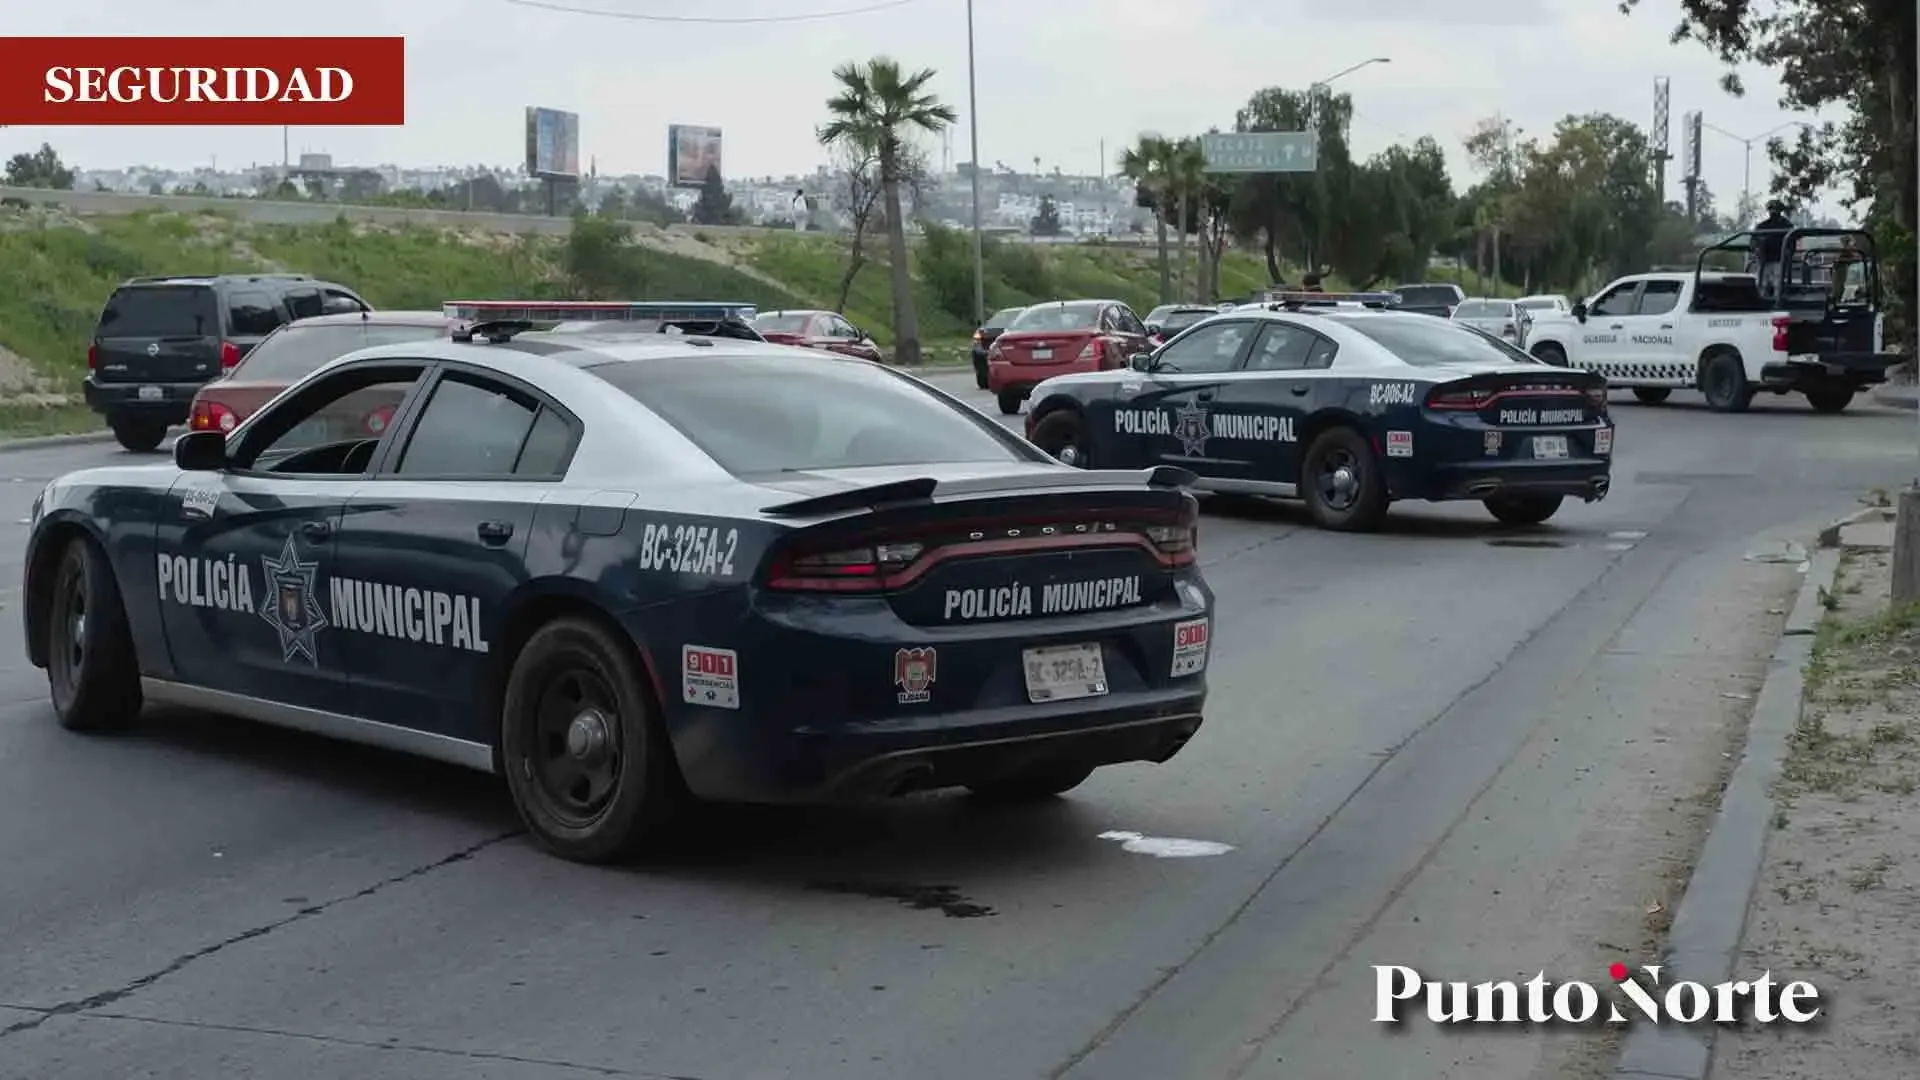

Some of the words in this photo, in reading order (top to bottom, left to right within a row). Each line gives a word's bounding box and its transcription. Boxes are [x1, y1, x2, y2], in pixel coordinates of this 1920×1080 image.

[1631, 334, 1673, 345] NACIONAL
[1115, 407, 1170, 435] POLICÍA
[1212, 413, 1297, 442] MUNICIPAL
[1500, 408, 1537, 424] POLICÍA
[1540, 409, 1584, 424] MUNICIPAL
[640, 523, 737, 576] BC-325A-2
[157, 553, 255, 614] POLICÍA
[329, 576, 489, 652] MUNICIPAL
[944, 581, 1033, 619] POLICÍA
[1041, 575, 1142, 614] MUNICIPAL
[688, 653, 732, 674] 911
